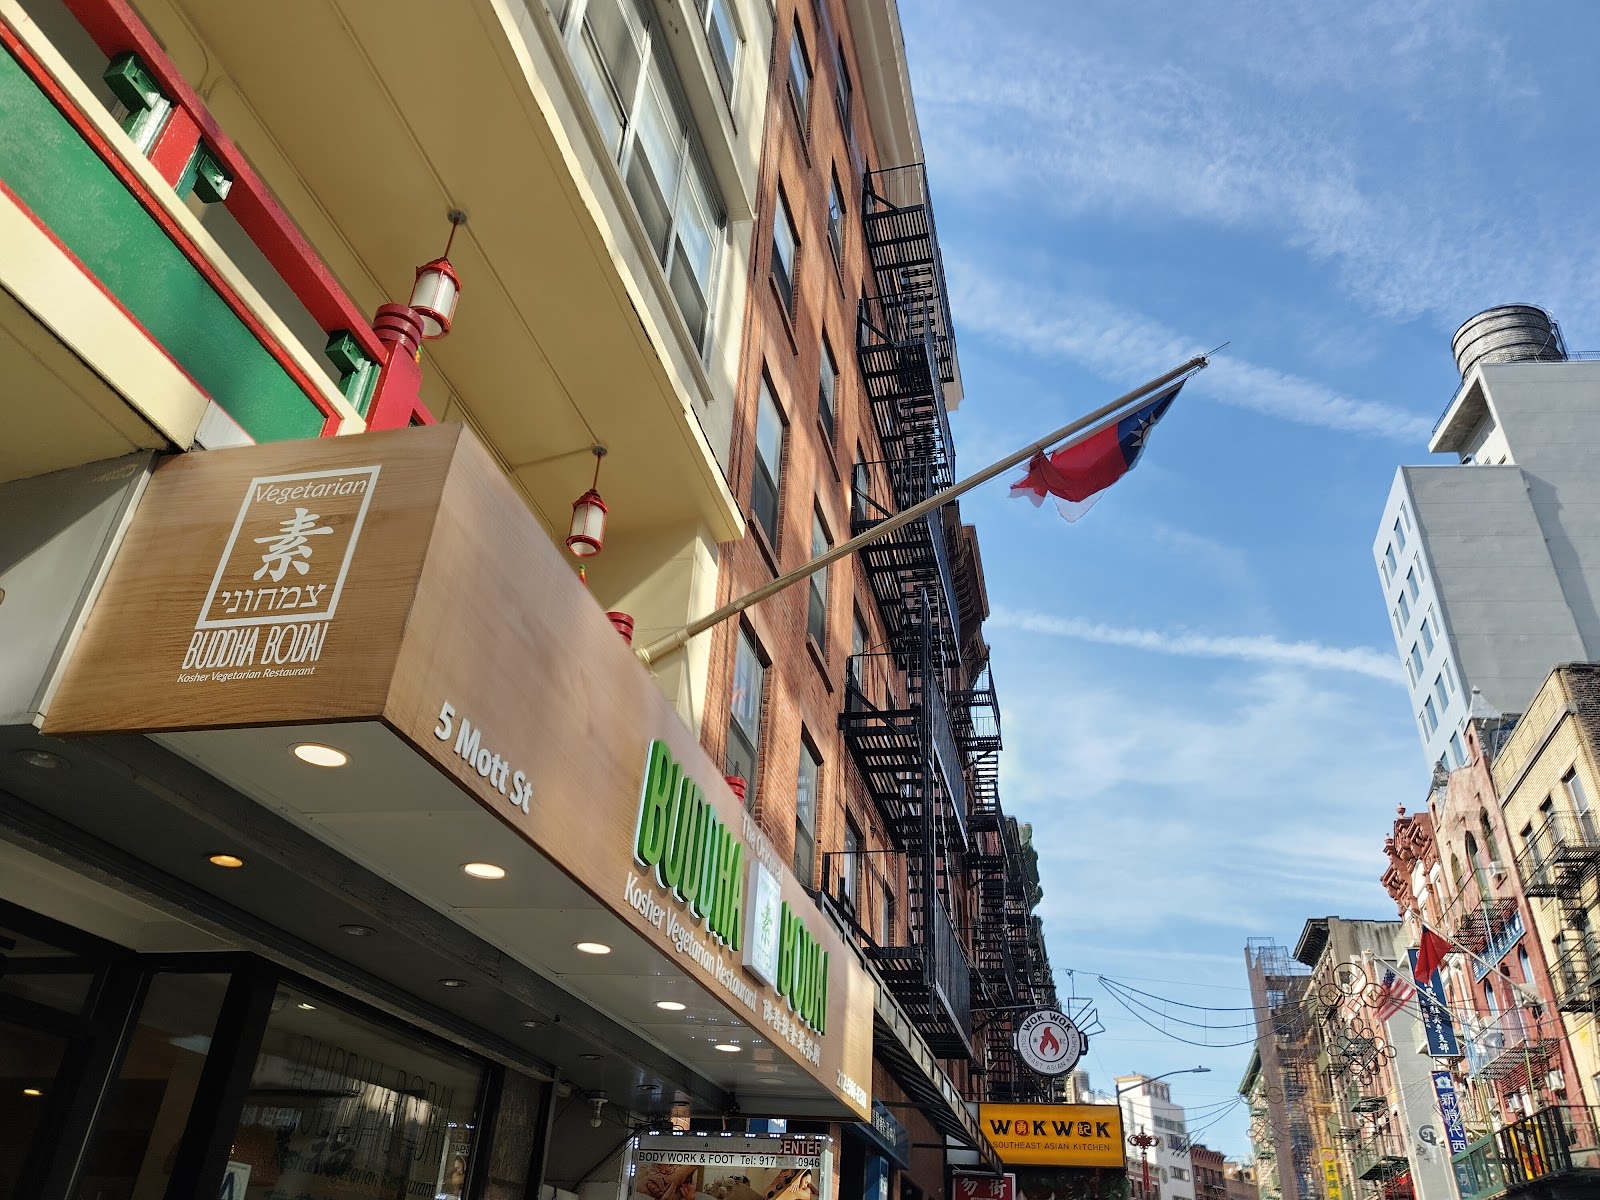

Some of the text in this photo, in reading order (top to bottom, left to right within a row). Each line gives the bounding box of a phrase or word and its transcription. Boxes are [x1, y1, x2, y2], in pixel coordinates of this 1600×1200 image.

[255, 477, 368, 505] Vegetarian
[253, 507, 334, 583] 素
[221, 584, 327, 614] צמחוני
[182, 621, 330, 670] BUDDHA BODAI
[177, 666, 316, 684] Kosher Vegetarian Restaurant
[434, 700, 533, 815] 5 Mott St
[633, 738, 829, 1036] BUDDHA BODAI
[623, 872, 667, 930] Kosher
[666, 907, 716, 976] Vegetarian
[714, 955, 757, 1013] Restaurant
[1022, 1012, 1073, 1033] WOK WOK
[1021, 1033, 1078, 1071] SOUTHEAST ASIAN KITCHEN
[638, 1152, 665, 1163] BODY
[667, 1153, 697, 1164] WORK
[699, 1154, 706, 1164] &
[708, 1154, 735, 1165] FOOT
[740, 1155, 756, 1166] Tel:
[993, 1141, 1110, 1151] SOUTHEAST ASIAN KITCHEN
